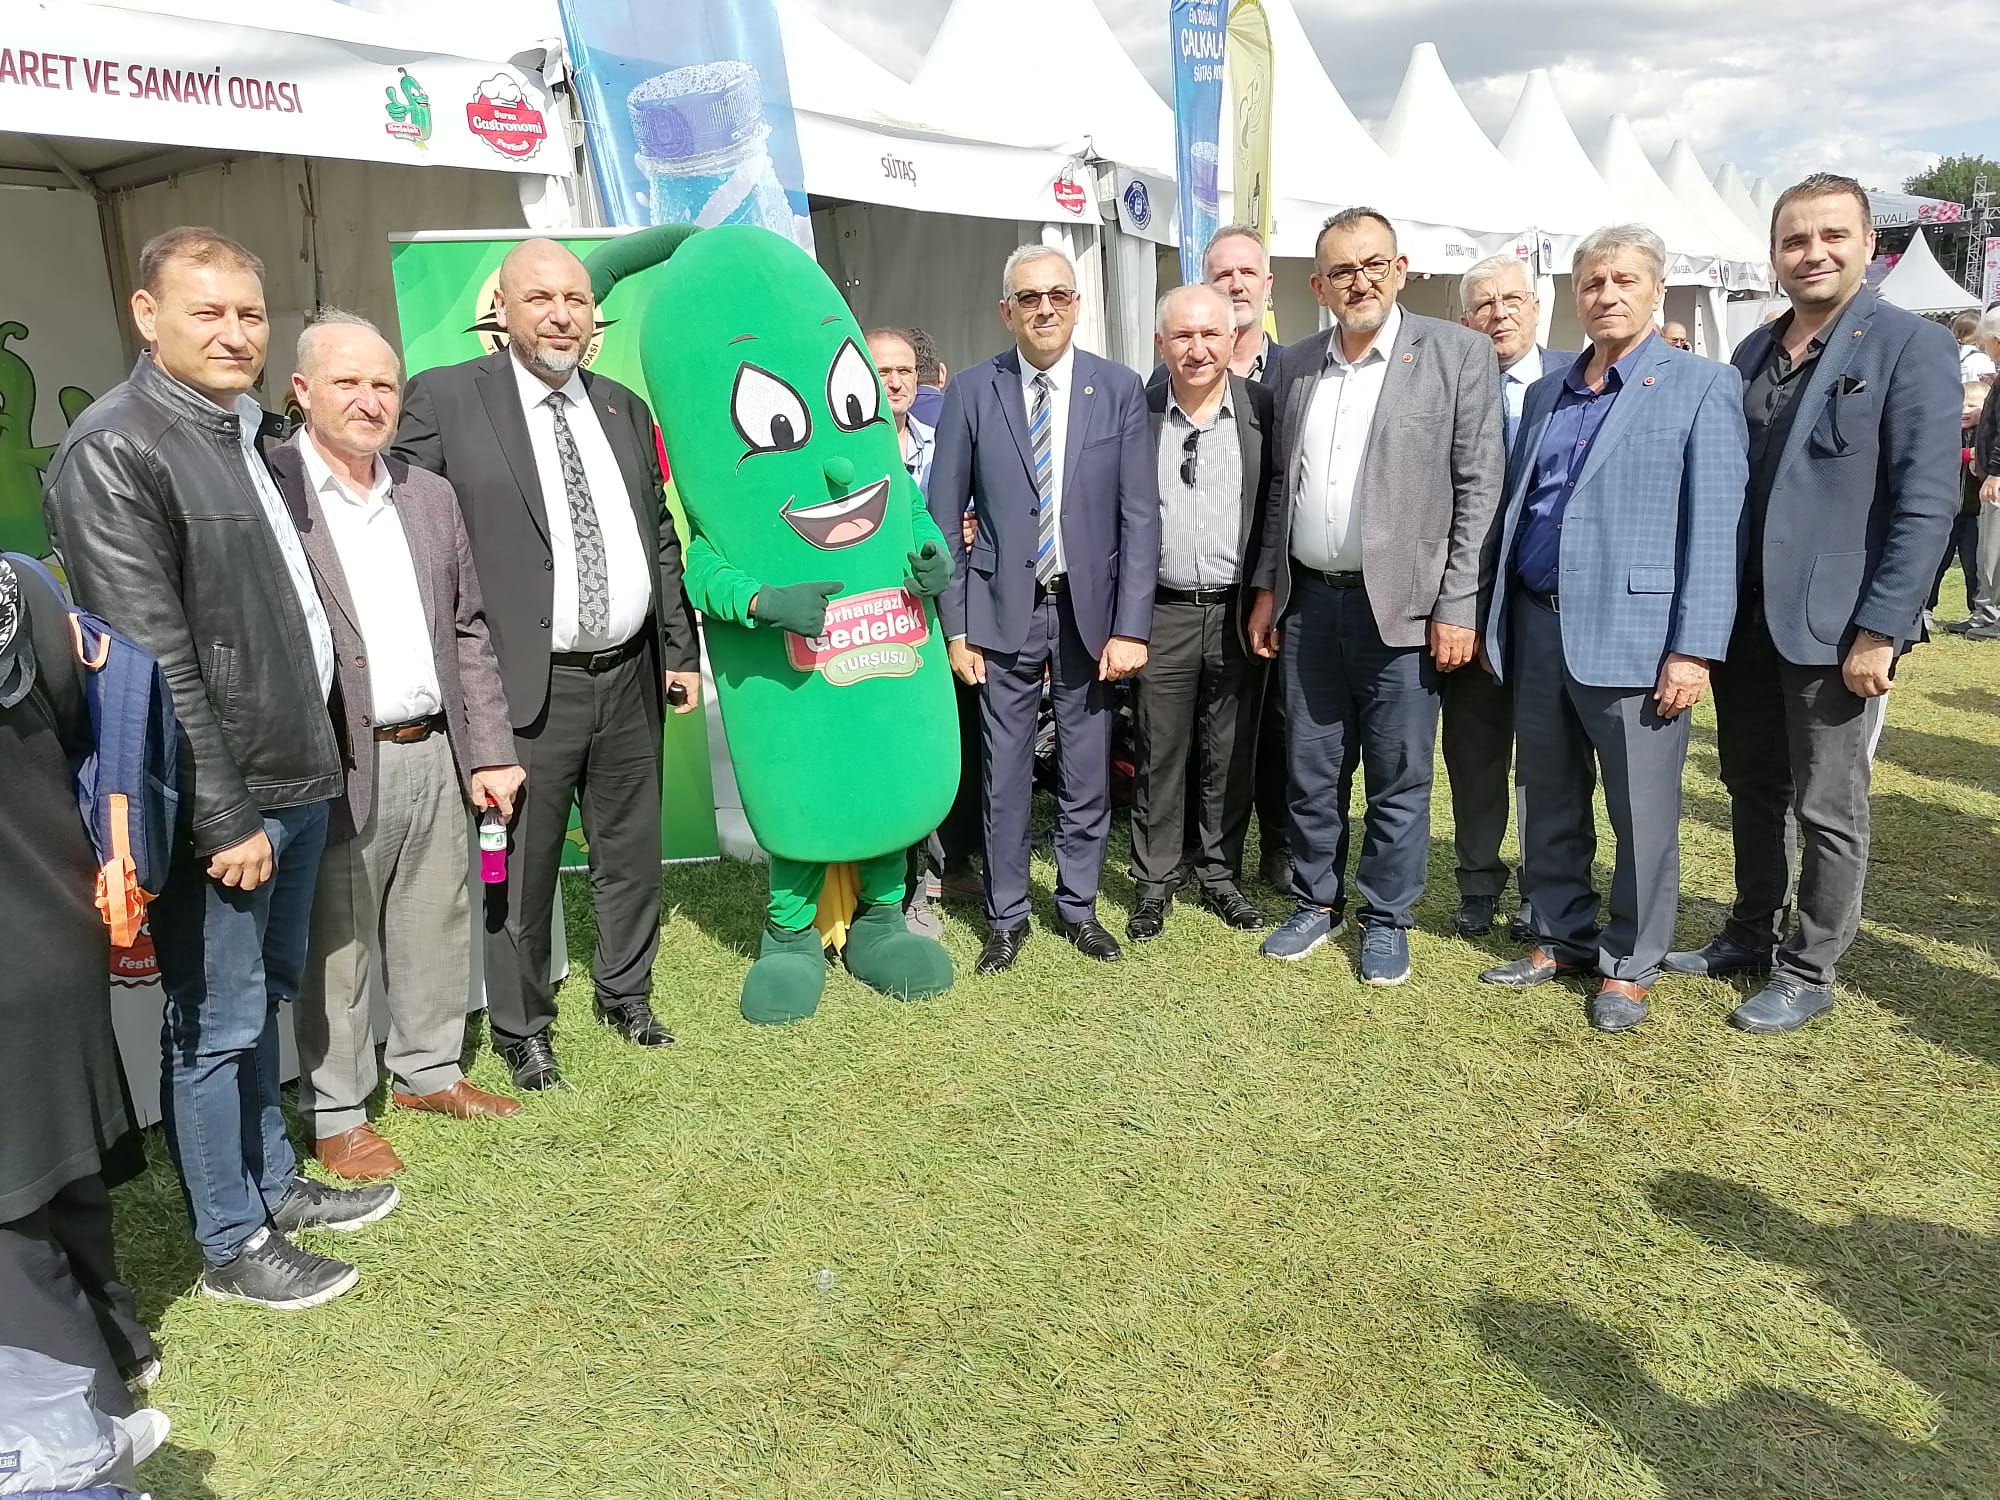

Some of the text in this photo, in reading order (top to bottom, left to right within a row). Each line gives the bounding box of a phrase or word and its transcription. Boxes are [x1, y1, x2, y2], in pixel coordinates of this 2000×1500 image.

[1181, 27, 1224, 64] ÇALKALA
[0, 48, 304, 114] ARET VE SANAYİ ODASI
[1193, 63, 1212, 84] SÜTAŞ
[472, 115, 543, 135] Gastronomi
[881, 153, 917, 187] SÜTAŞ
[805, 605, 922, 653] Gedelek
[836, 650, 908, 675] TURŞUSU
